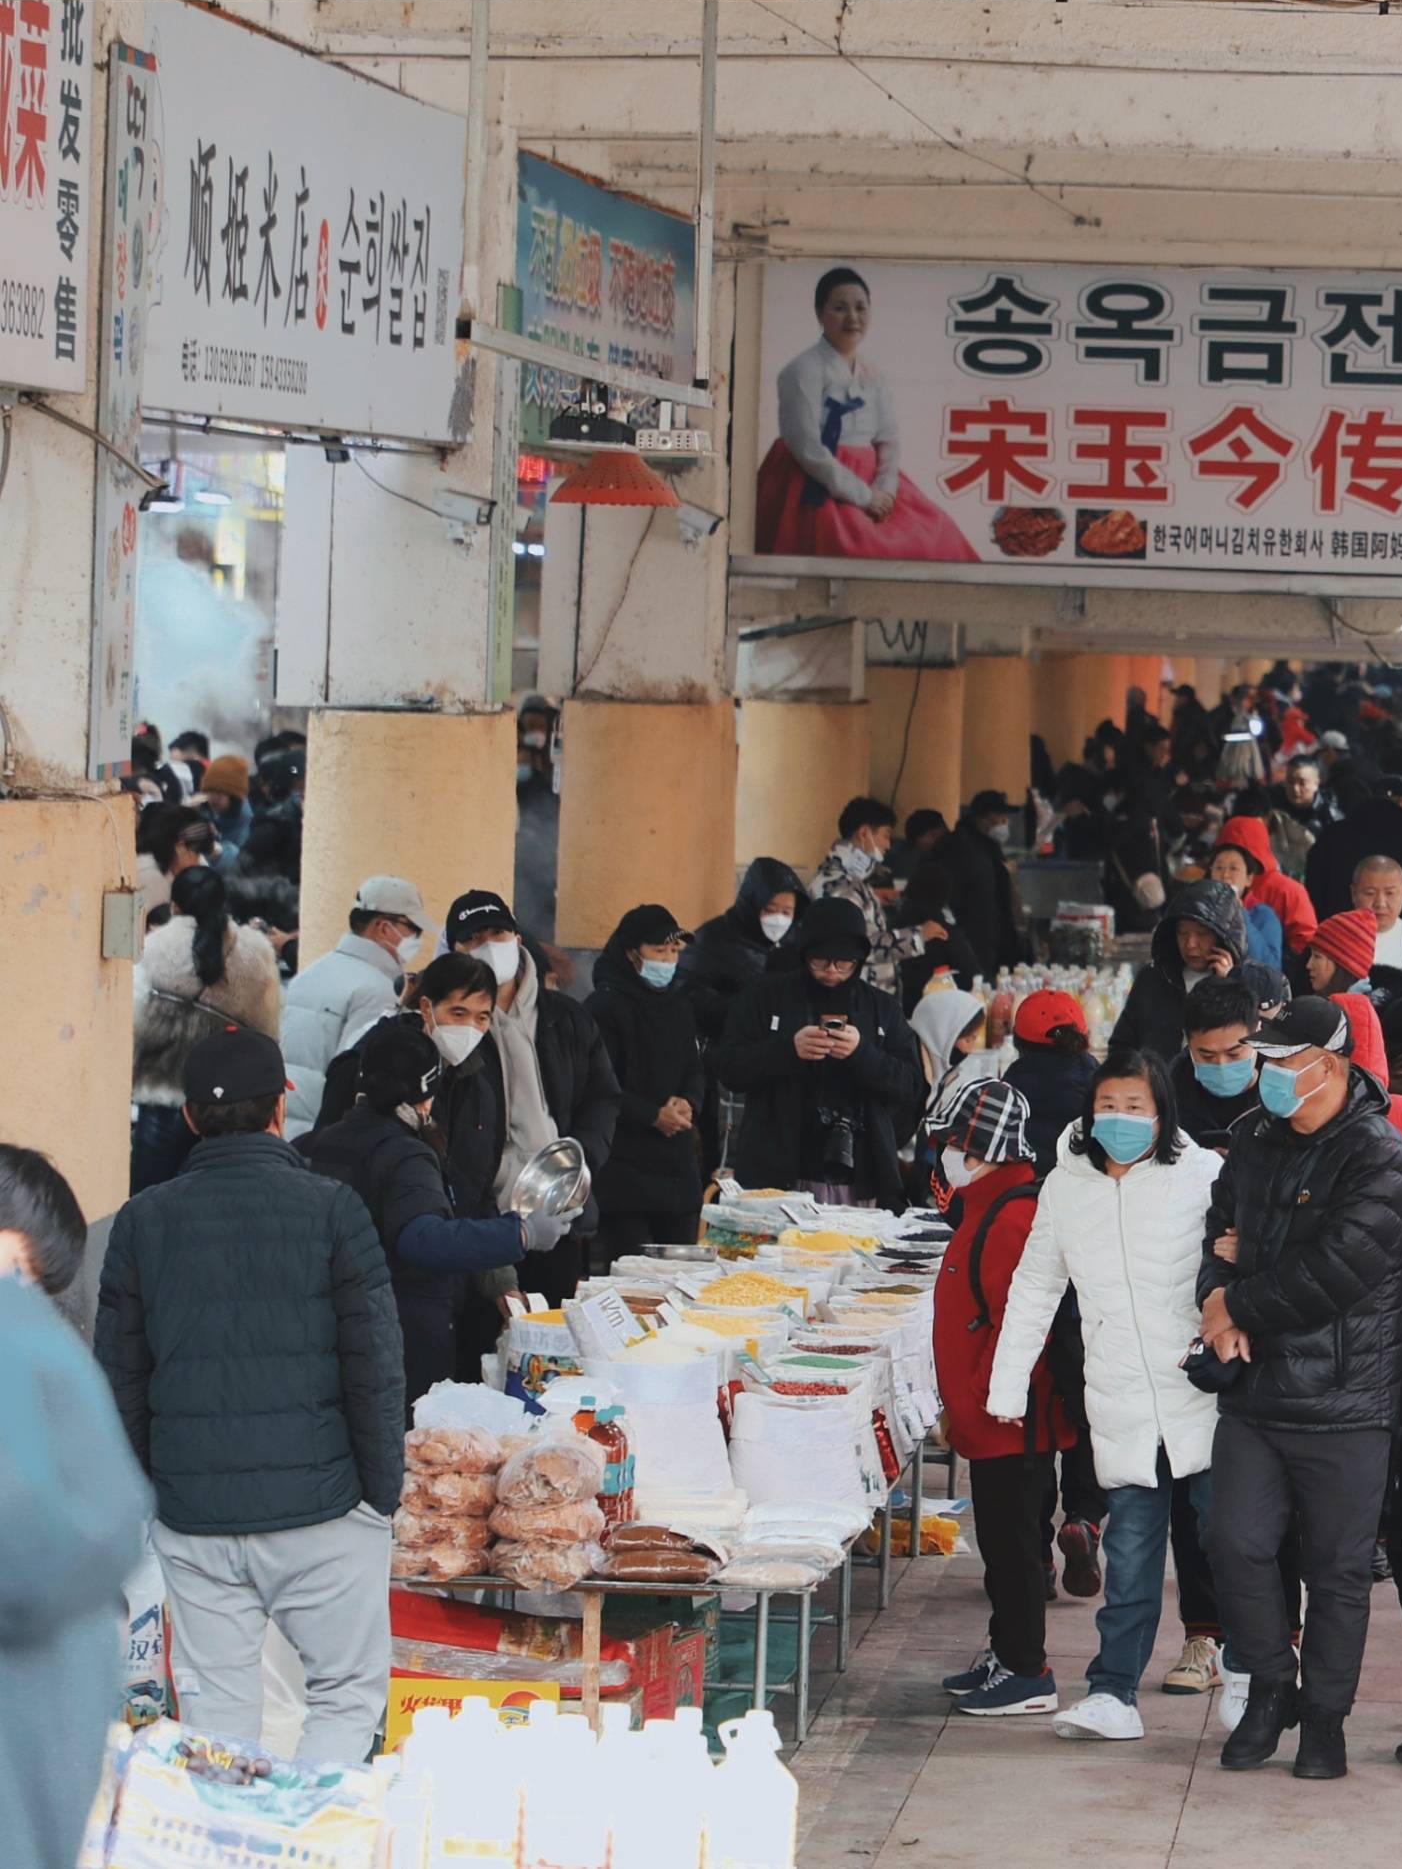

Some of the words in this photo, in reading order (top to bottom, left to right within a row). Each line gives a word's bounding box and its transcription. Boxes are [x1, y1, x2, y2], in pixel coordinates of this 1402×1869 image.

[54, 0, 84, 363] 批发零售
[183, 135, 312, 330] 顺姬米店
[338, 185, 432, 354] 순희쌀집
[1152, 524, 1325, 558] 한국어머니김치유한회사
